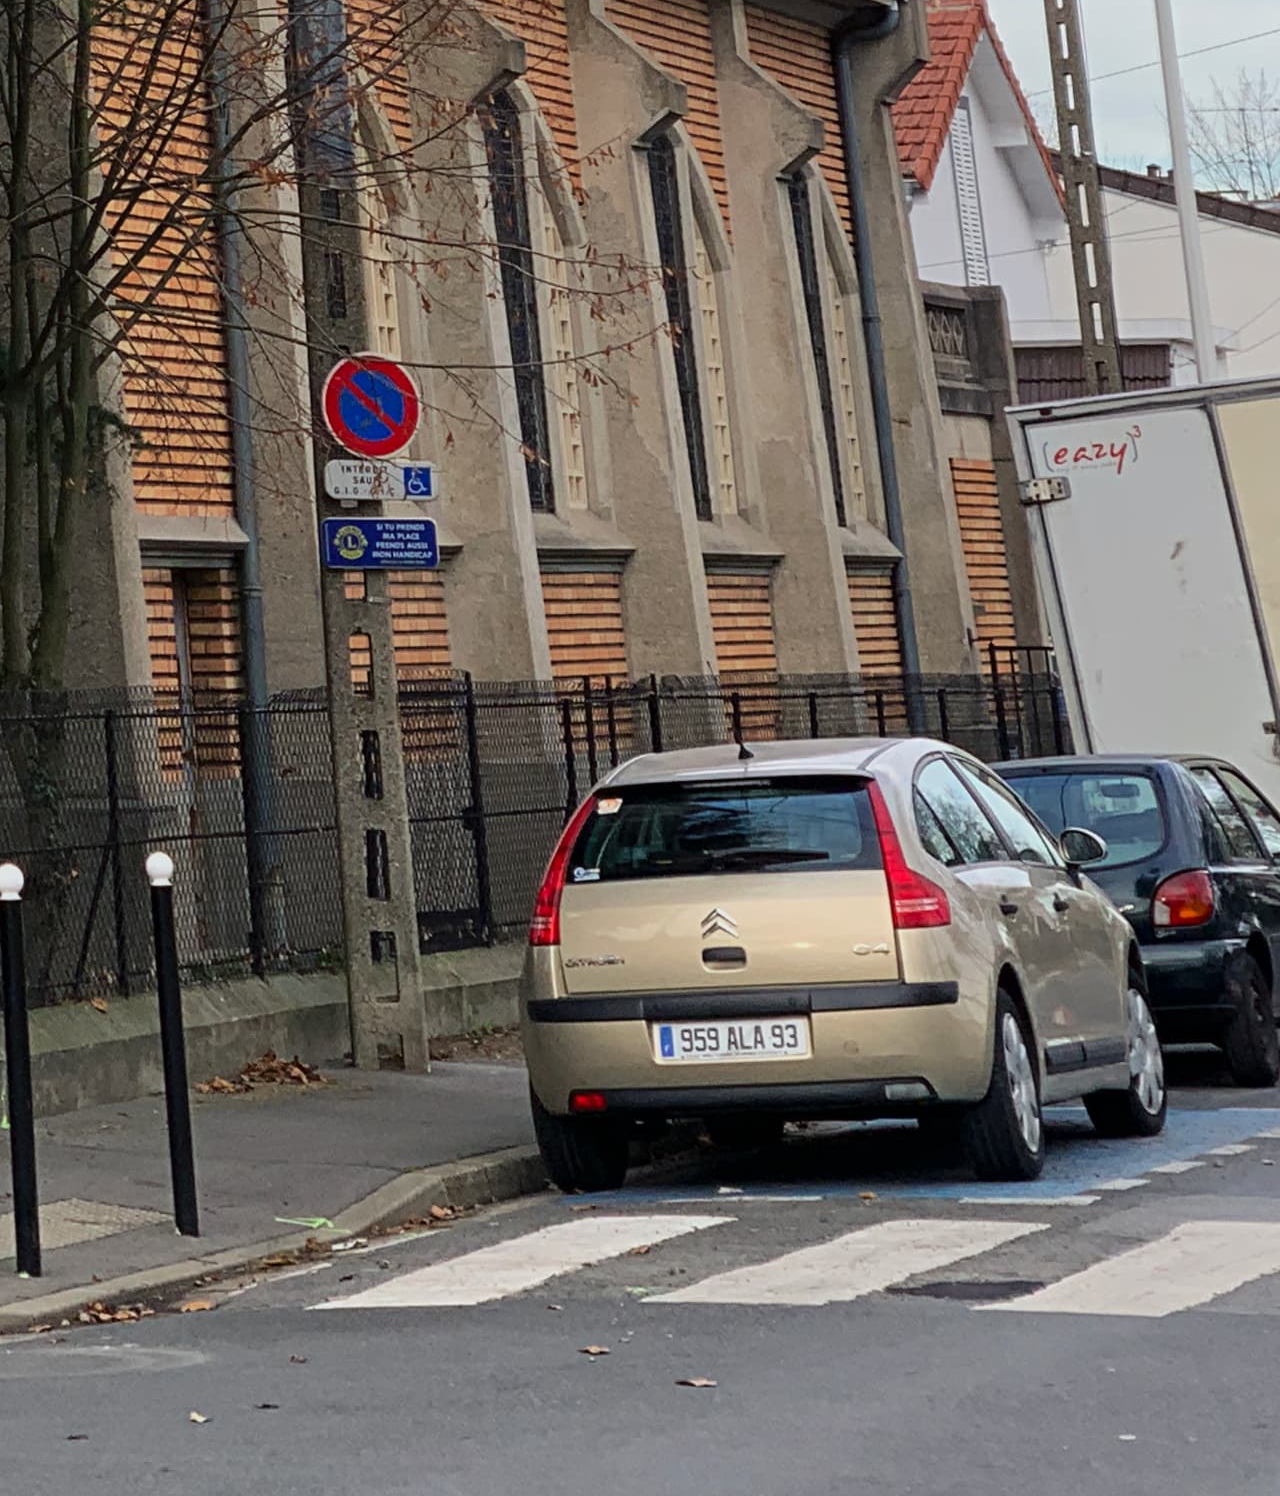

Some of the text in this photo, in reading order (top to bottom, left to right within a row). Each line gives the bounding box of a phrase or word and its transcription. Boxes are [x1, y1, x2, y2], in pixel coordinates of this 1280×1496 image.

[680, 1023, 799, 1052] 959 ALA 93
